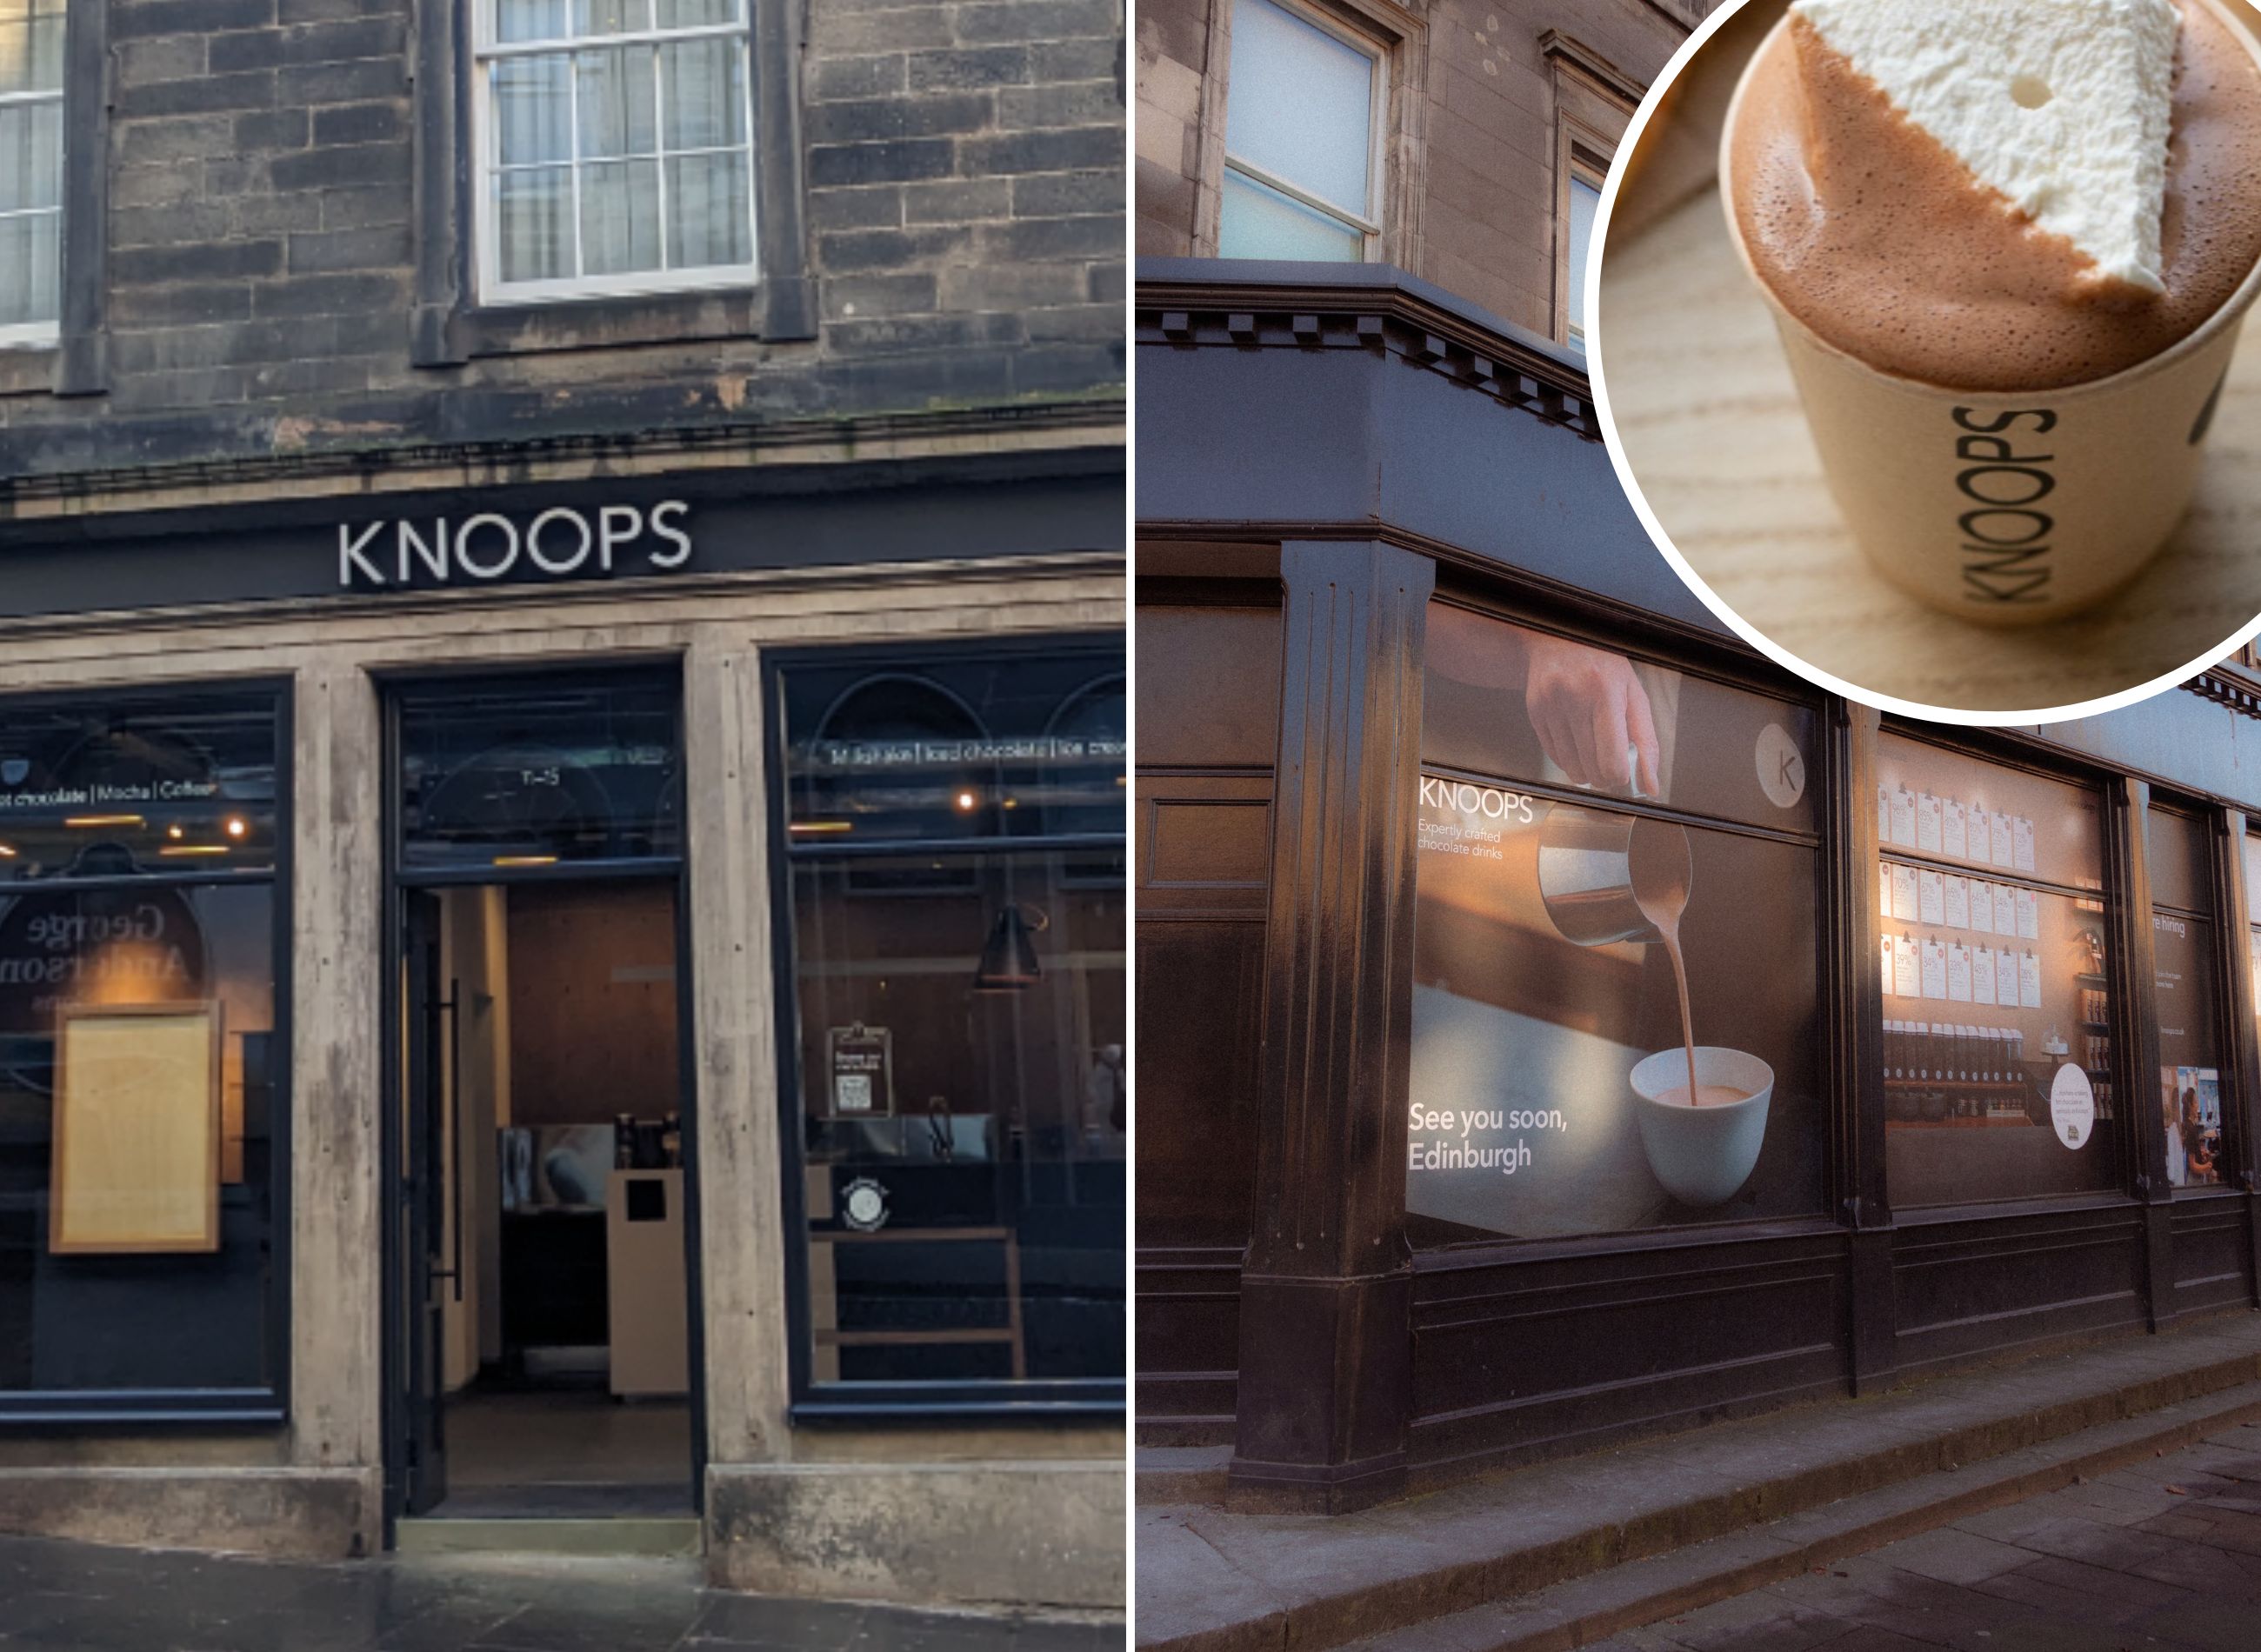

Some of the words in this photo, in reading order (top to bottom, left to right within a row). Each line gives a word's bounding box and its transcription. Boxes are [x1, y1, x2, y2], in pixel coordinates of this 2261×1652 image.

[1951, 405, 2058, 604] KNOOPS
[338, 500, 692, 586] KNOOPS
[1779, 749, 1797, 793] K
[1419, 776, 1534, 823] KNOOPS
[1417, 837, 1470, 856] chocolate
[1472, 845, 1503, 860] drinks
[1418, 819, 1462, 839] Expertly
[1464, 827, 1501, 843] crafted
[2162, 915, 2185, 938] hiring
[1409, 1102, 1455, 1130] See
[1460, 1110, 1503, 1138] you
[1509, 1109, 1567, 1132] soon,
[1409, 1138, 1531, 1175] Edinburgh
